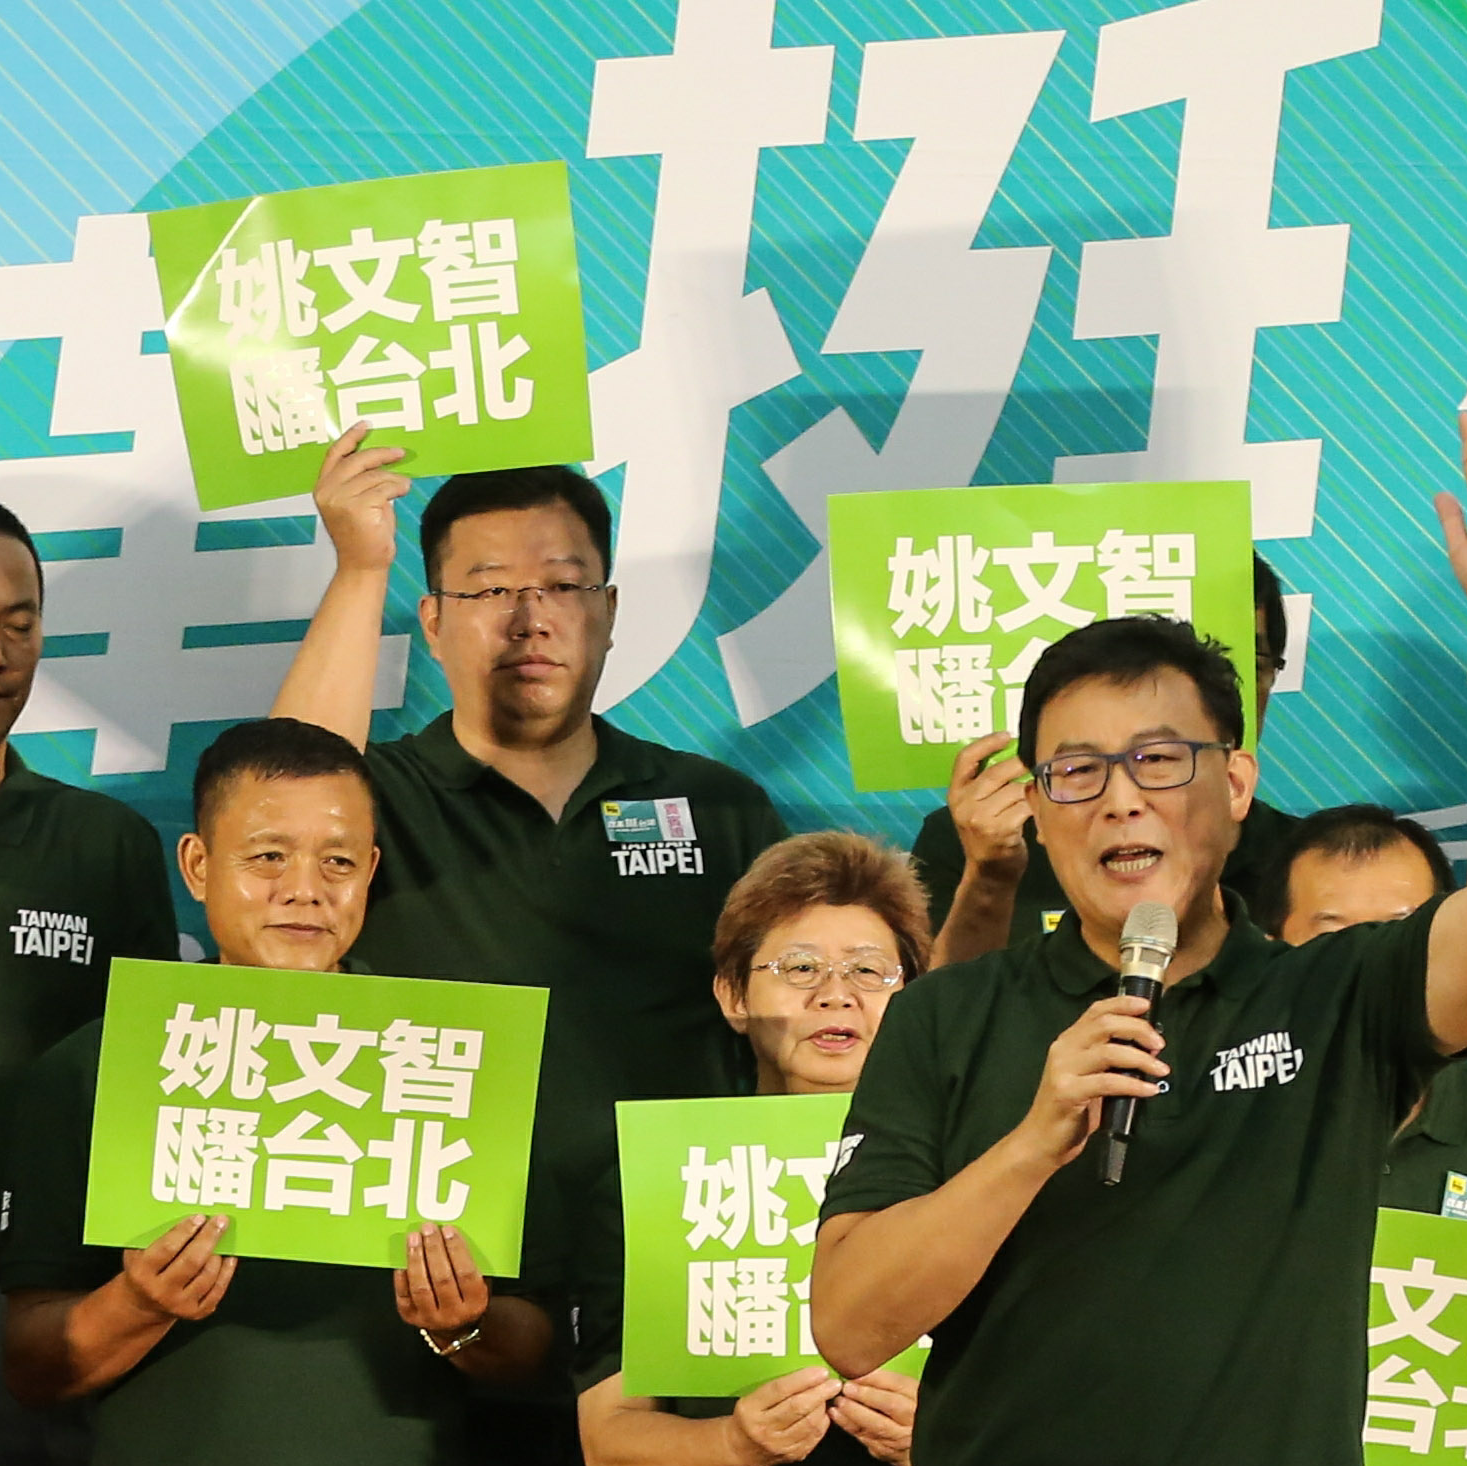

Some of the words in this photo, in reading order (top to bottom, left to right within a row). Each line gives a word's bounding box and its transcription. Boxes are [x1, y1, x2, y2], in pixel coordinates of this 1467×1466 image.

[215, 217, 520, 343] 姚文智
[887, 529, 1196, 639] 姚文智
[611, 847, 704, 877] TAIPEI
[17, 909, 88, 934] TAIWAN
[9, 925, 95, 966] TAIPEI
[158, 1003, 484, 1119] 姚文智
[1215, 1031, 1292, 1066] TAIWAN
